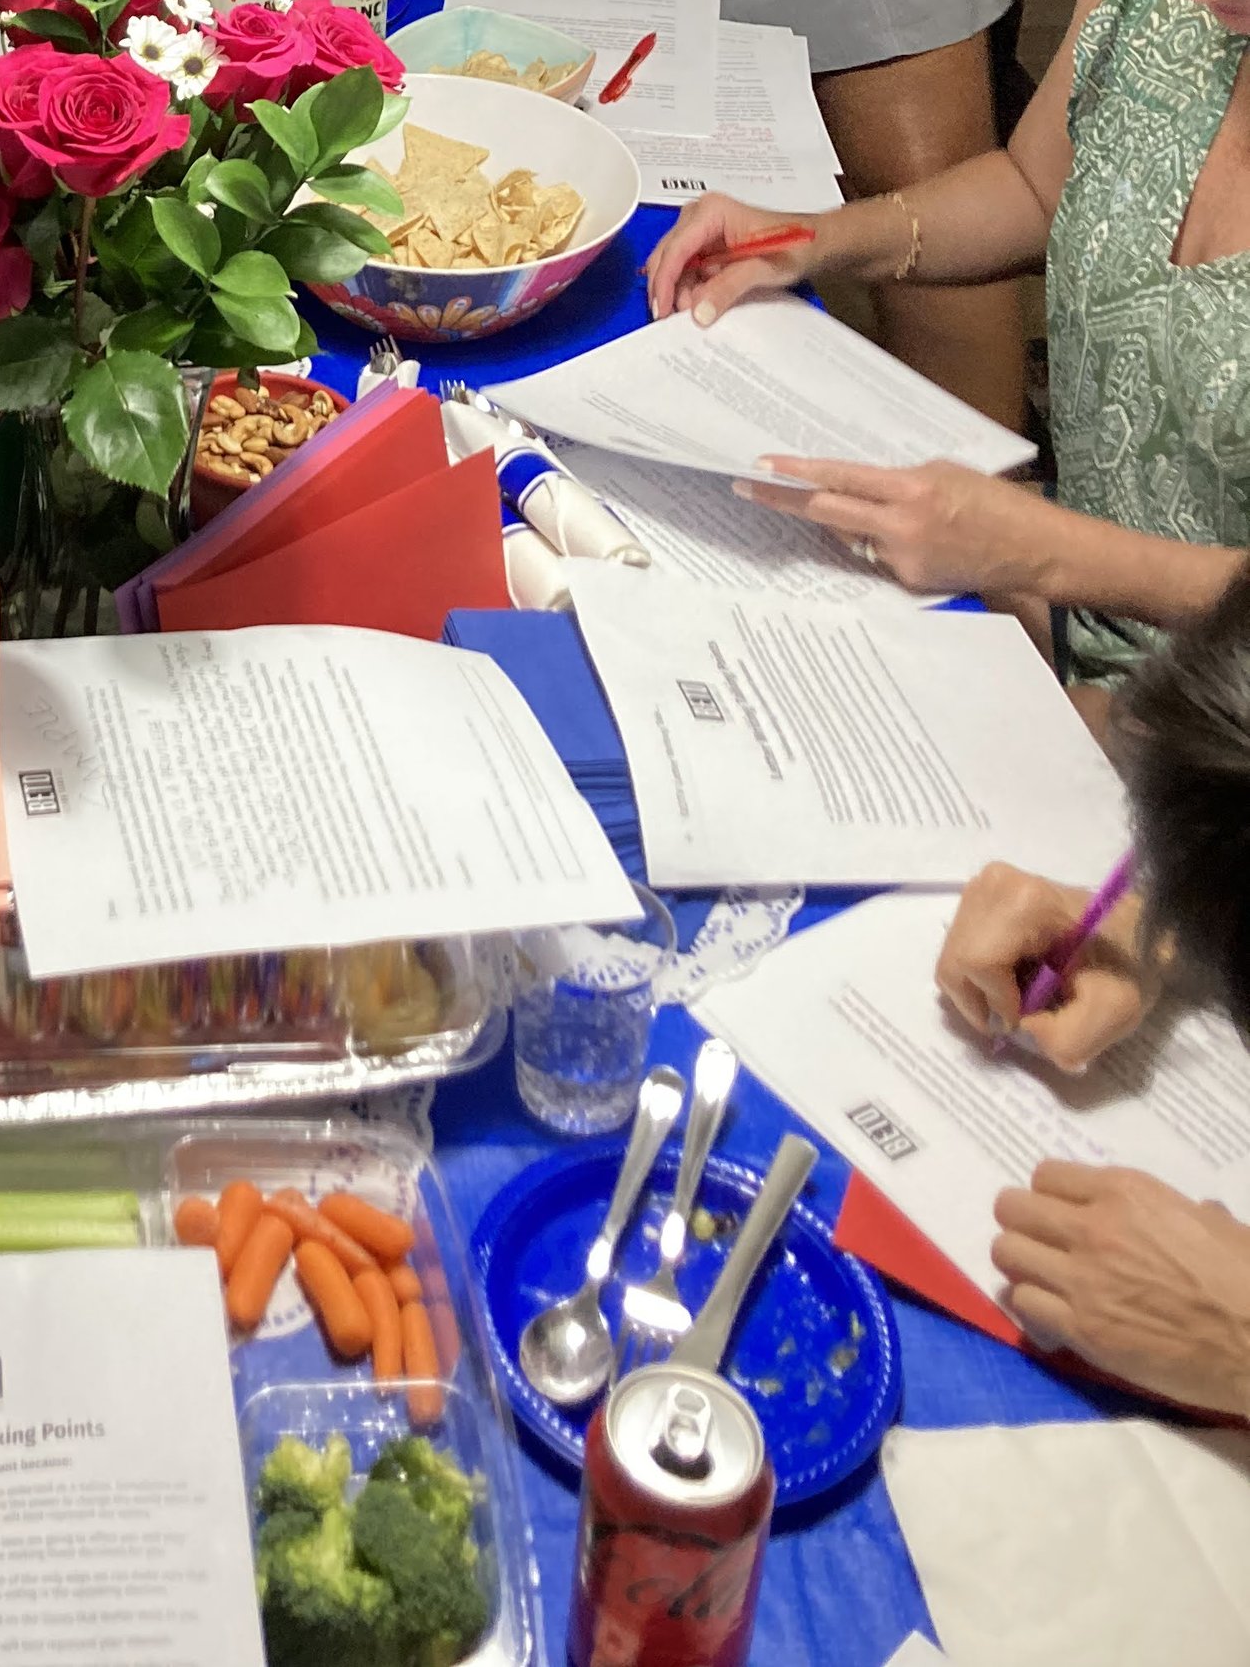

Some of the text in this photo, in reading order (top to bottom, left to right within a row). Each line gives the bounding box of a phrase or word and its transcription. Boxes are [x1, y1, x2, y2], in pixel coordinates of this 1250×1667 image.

[21, 772, 58, 814] BETO
[851, 1105, 913, 1157] BETO
[41, 1418, 106, 1441] Points
